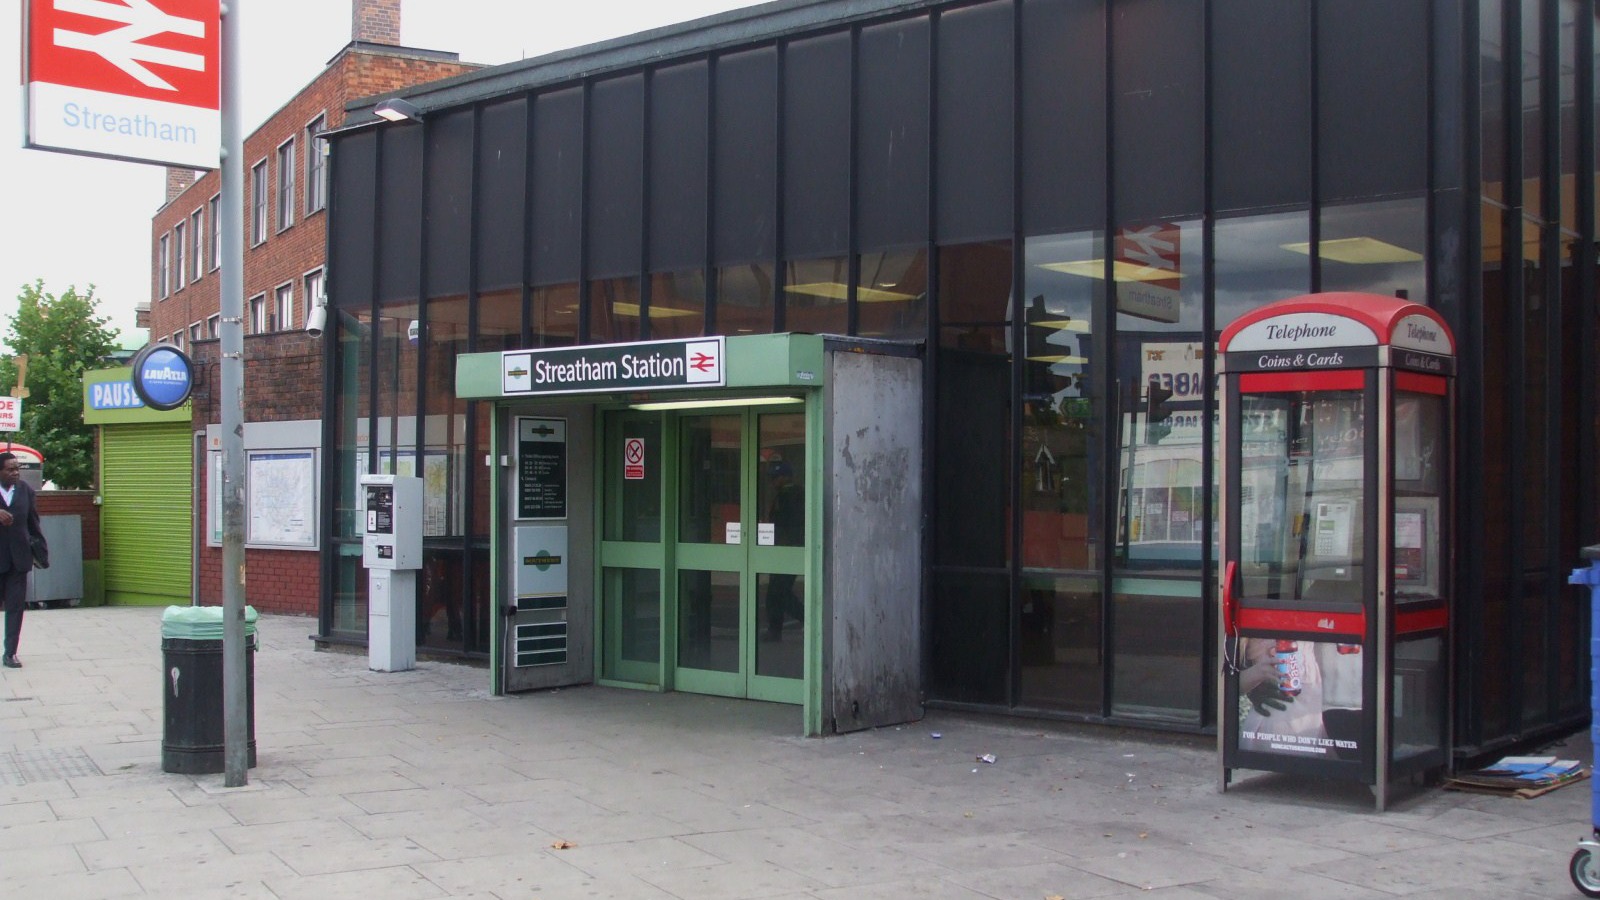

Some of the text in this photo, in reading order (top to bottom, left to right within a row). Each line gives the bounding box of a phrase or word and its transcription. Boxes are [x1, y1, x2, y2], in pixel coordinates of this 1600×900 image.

[63, 102, 197, 144] Streatham
[1266, 323, 1337, 341] Telephone
[1407, 323, 1437, 343] Telephone
[535, 353, 684, 384] Streatham Station
[1258, 352, 1344, 368] Coins & Cards
[144, 366, 187, 381] LAVAZZA
[1242, 731, 1255, 739] FOR
[1257, 732, 1281, 742] PEOPLE
[1282, 734, 1297, 743] WHO
[1298, 736, 1317, 745] DON'T
[1318, 738, 1335, 747] LIKE
[1335, 740, 1358, 749] WATER
